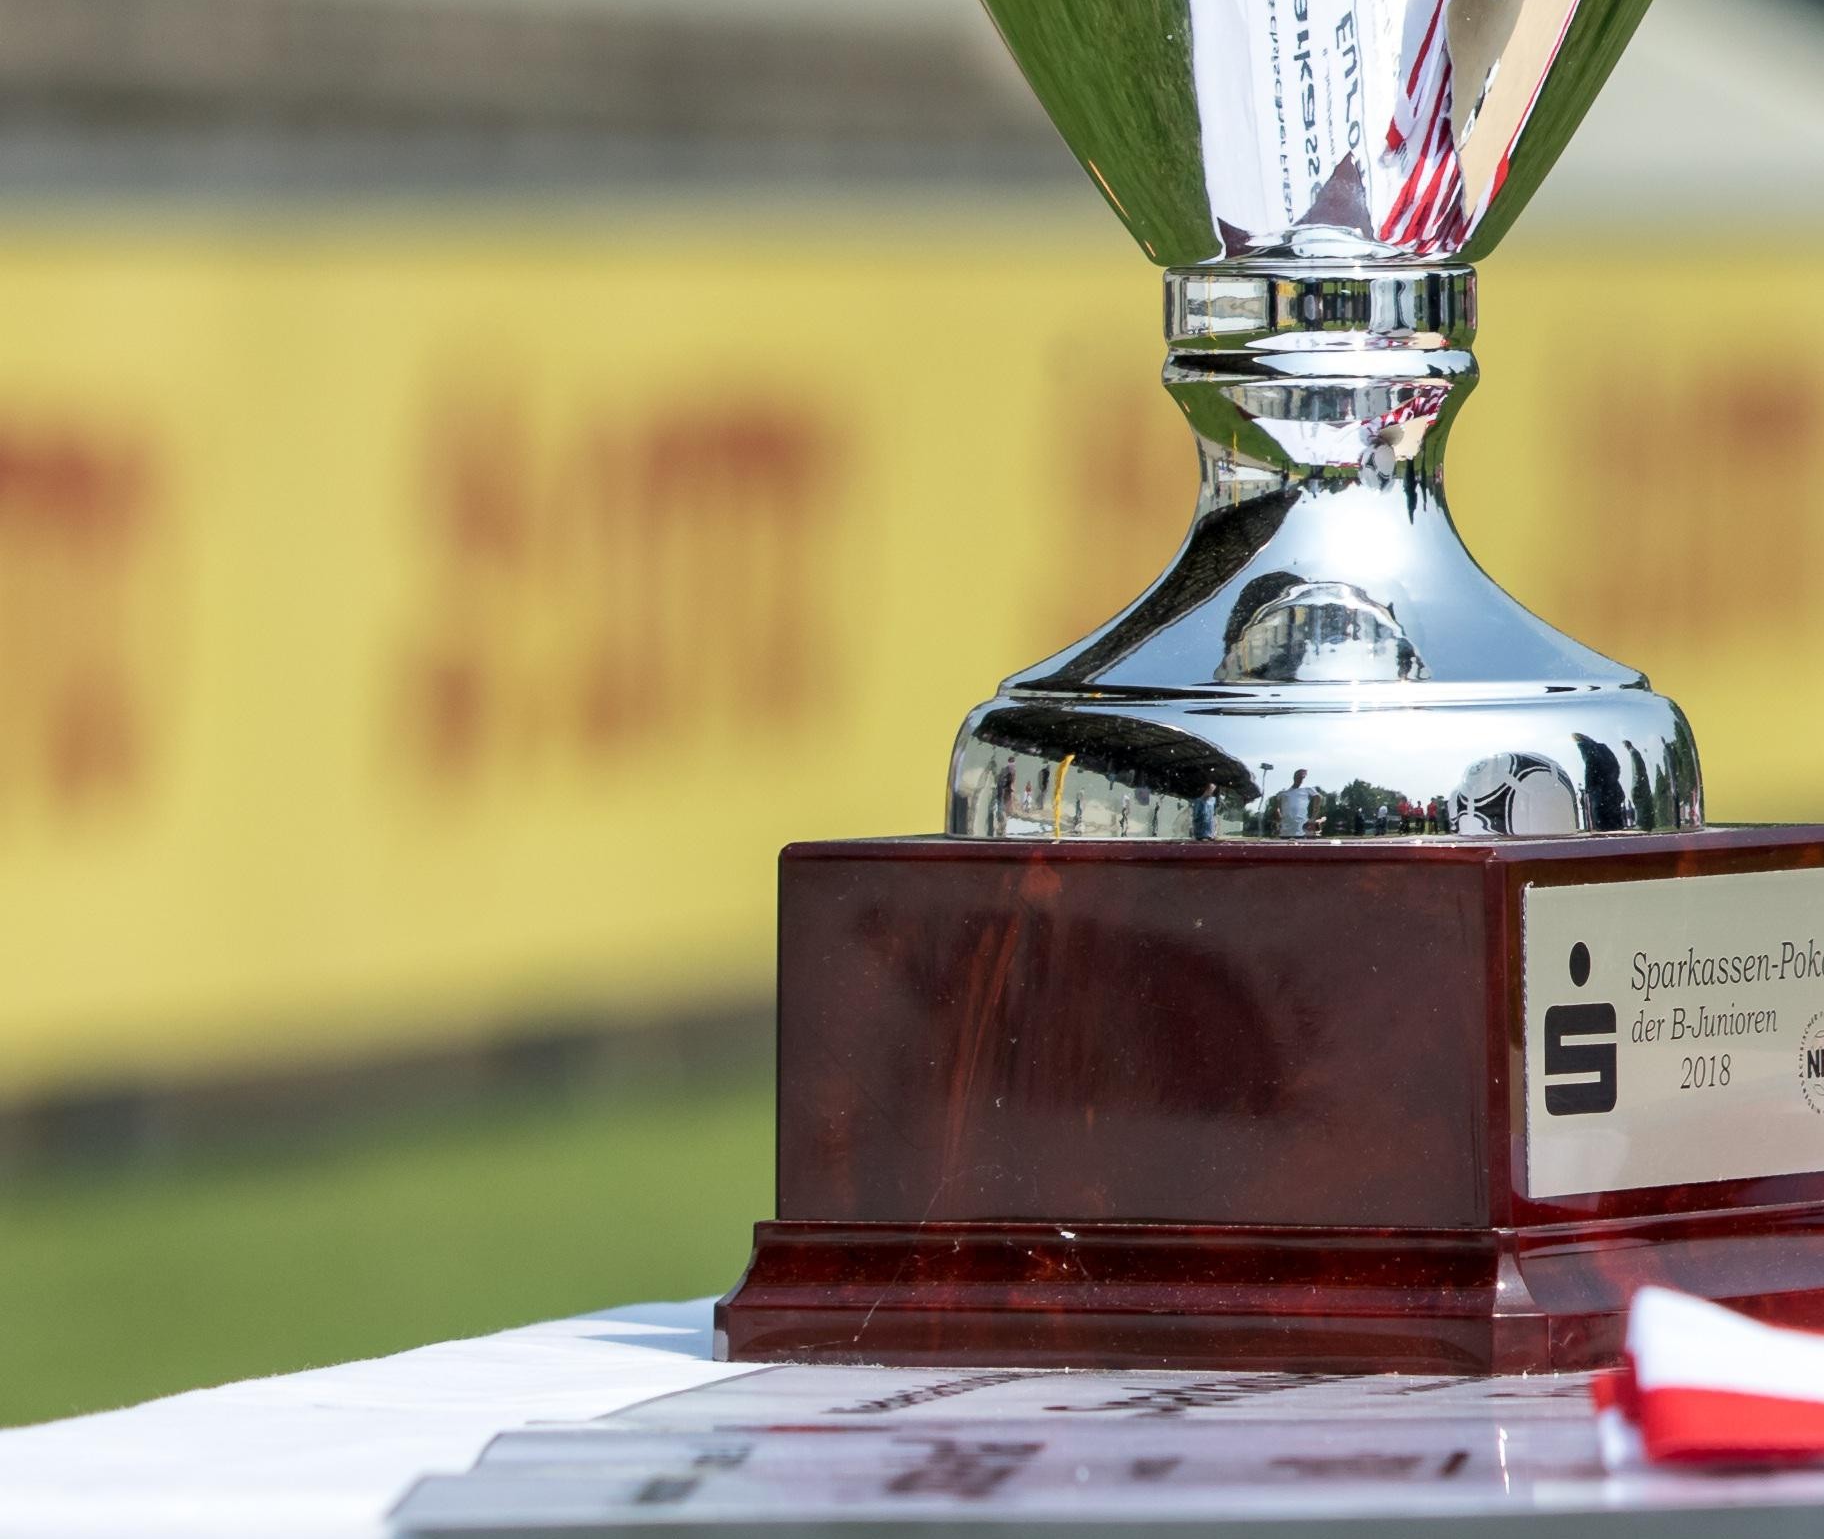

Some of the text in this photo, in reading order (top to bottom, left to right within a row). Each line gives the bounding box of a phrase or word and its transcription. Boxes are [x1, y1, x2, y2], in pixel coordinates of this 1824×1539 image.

[1631, 1001, 1778, 1044] der B-Junioren
[1680, 1053, 1732, 1090] 2018
